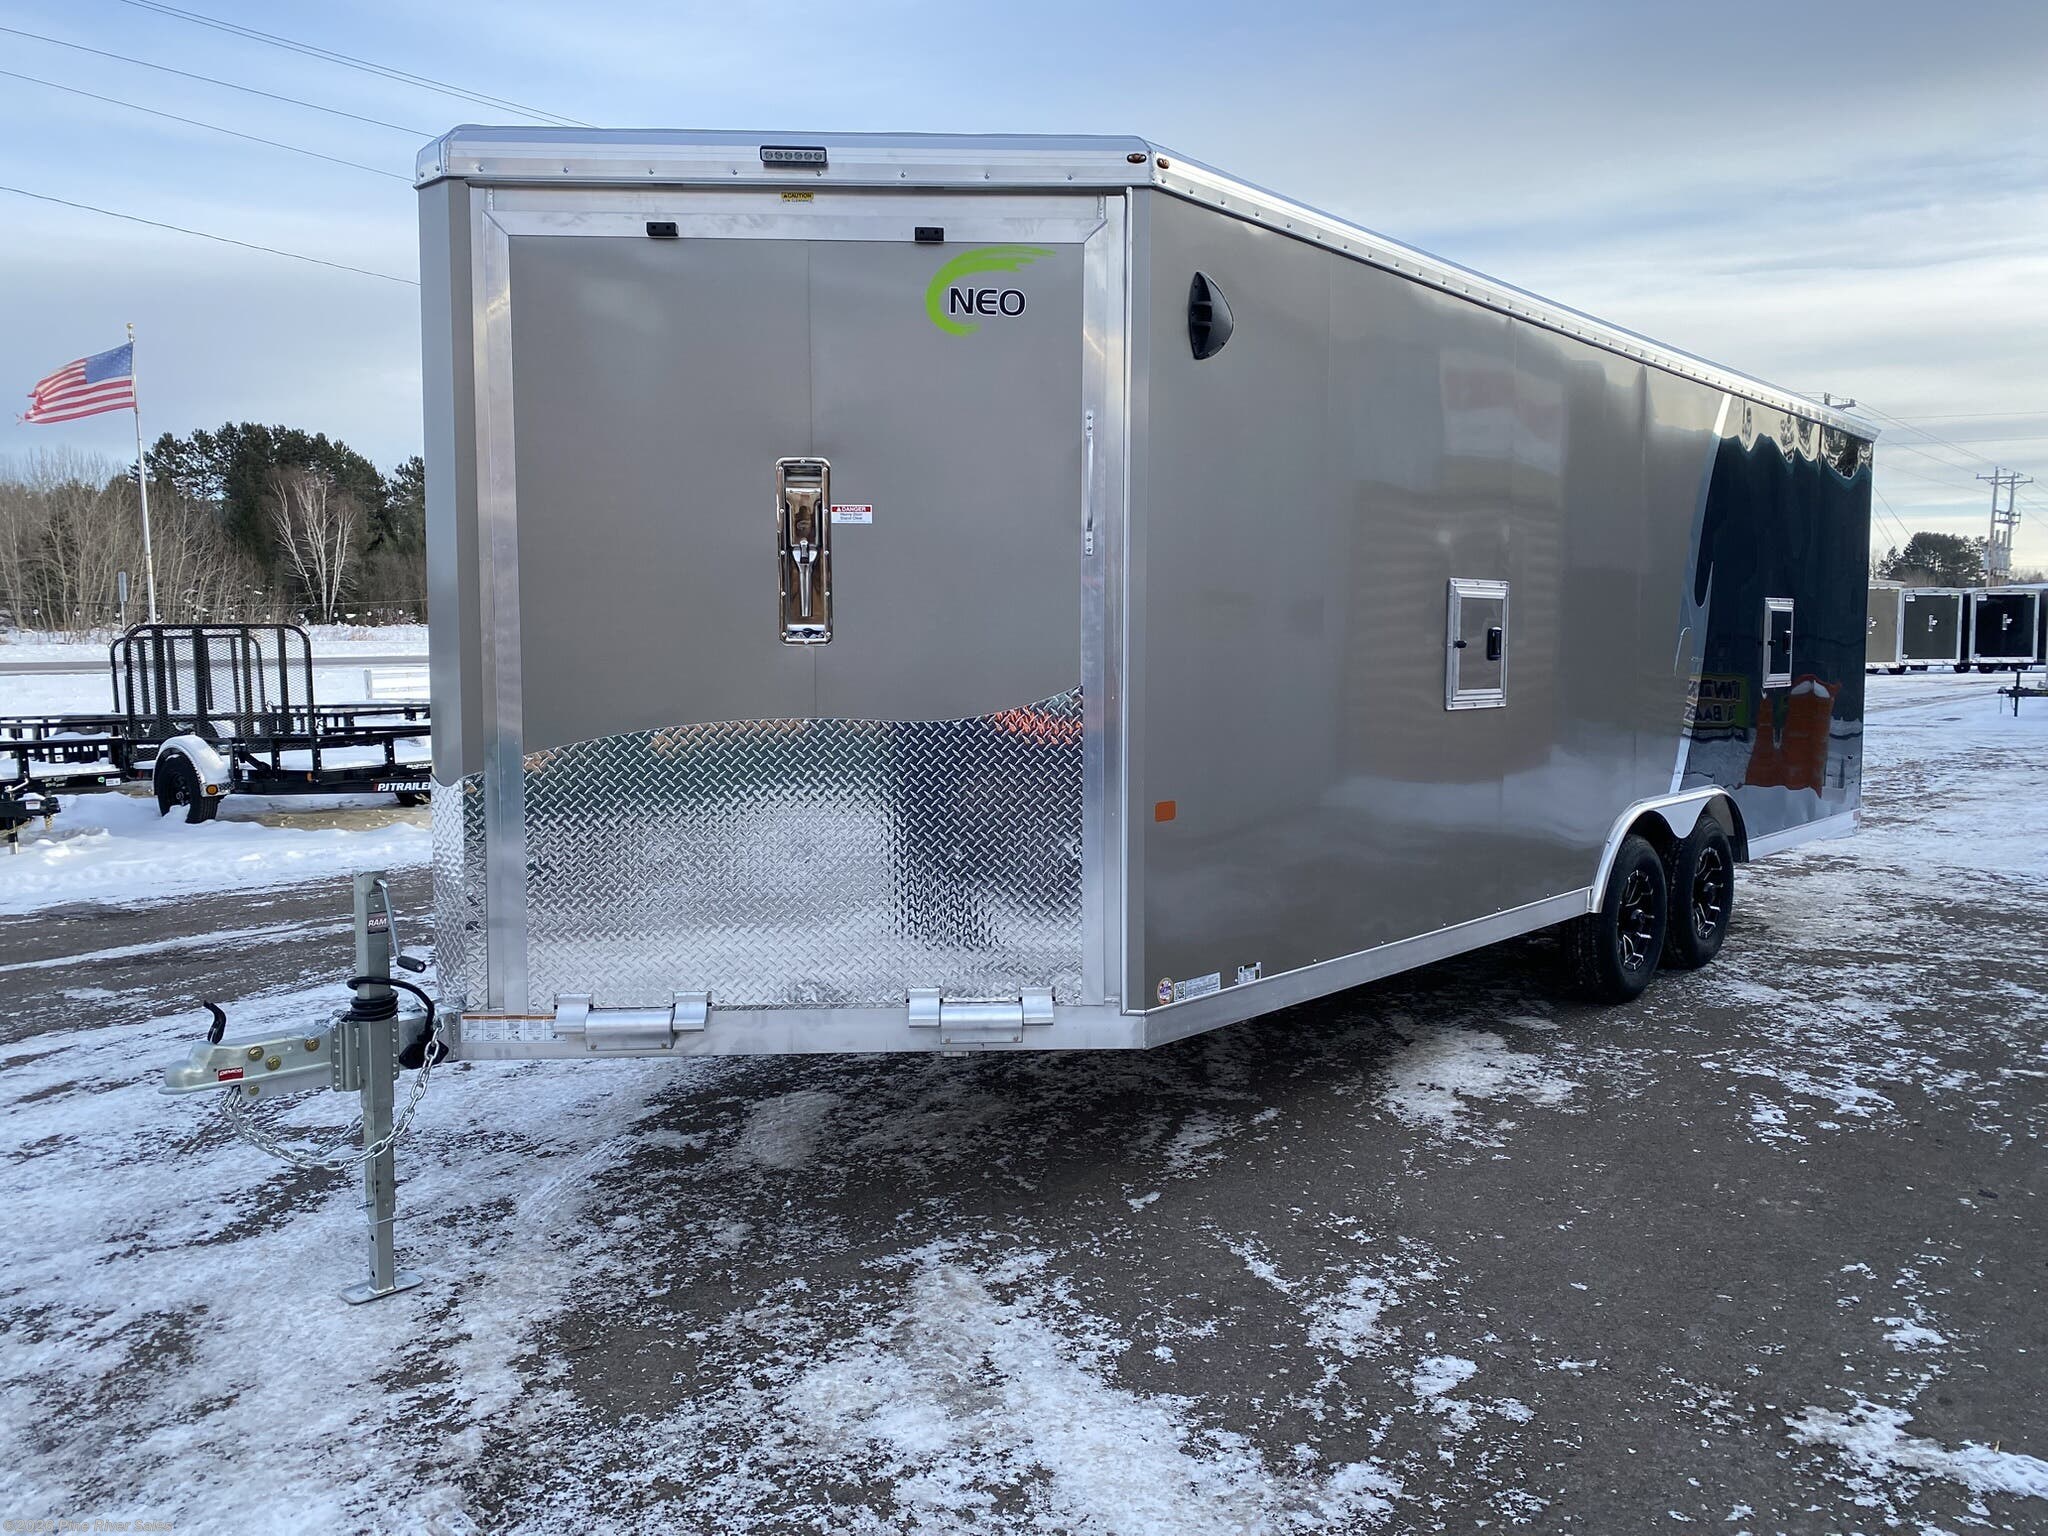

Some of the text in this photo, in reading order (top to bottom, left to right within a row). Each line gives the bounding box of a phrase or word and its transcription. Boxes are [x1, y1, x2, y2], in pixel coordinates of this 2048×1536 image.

[949, 286, 1027, 318] NEO
[377, 783, 390, 792] PJ
[368, 918, 387, 927] RAM
